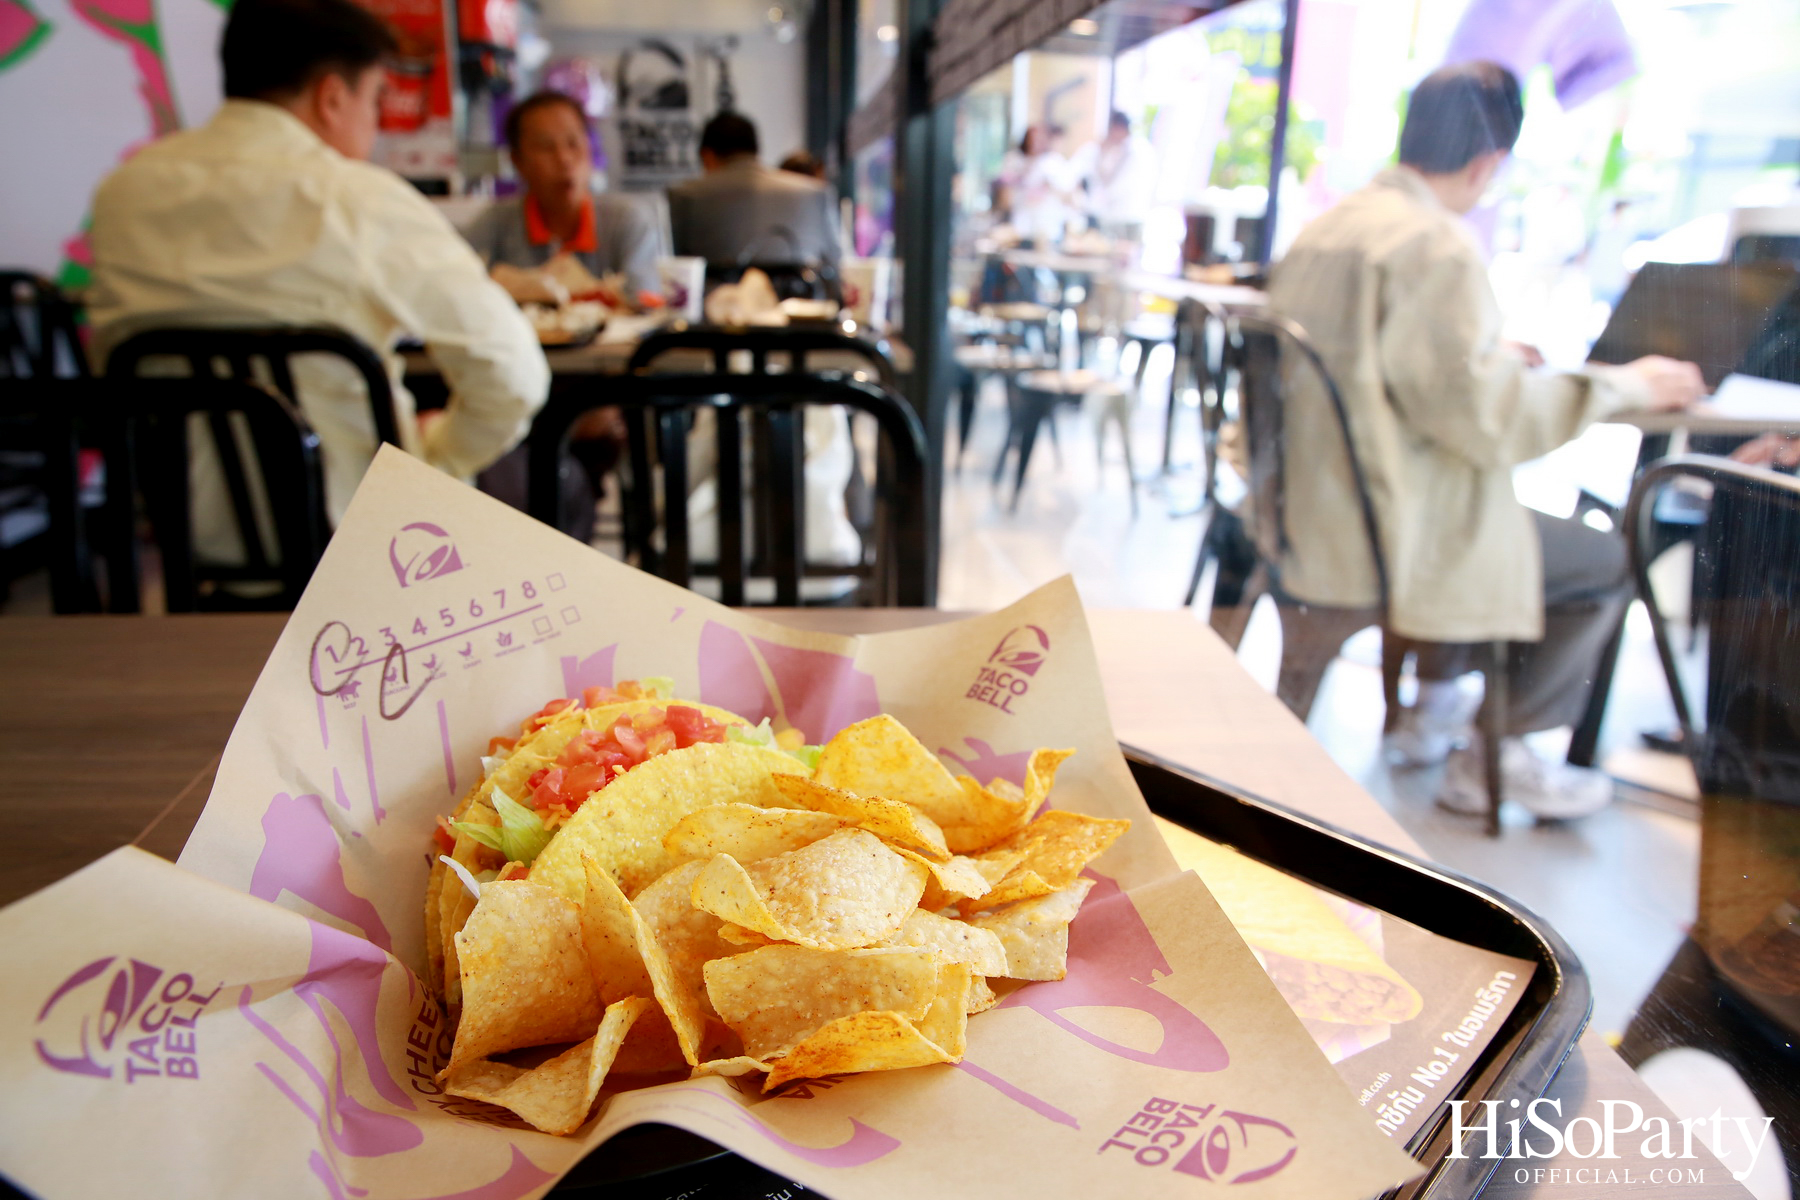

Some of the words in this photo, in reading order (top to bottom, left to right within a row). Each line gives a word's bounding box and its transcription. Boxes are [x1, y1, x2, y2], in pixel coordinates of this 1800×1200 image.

[325, 645, 340, 664] 1
[350, 637, 369, 656] 2
[379, 627, 397, 647] 3
[412, 618, 428, 636] 4
[439, 608, 455, 627] 5
[469, 599, 483, 617] 6
[493, 589, 506, 609] 7
[521, 581, 536, 599] 8
[965, 684, 1013, 714] BELL
[976, 667, 1028, 696] TACO
[125, 973, 194, 1083] TACO
[163, 984, 222, 1080] BELL
[1410, 1046, 1460, 1089] No.1
[1441, 970, 1517, 1048] ในอเมริกา
[1099, 1097, 1180, 1152] BELL
[1134, 1103, 1216, 1167] TACO
